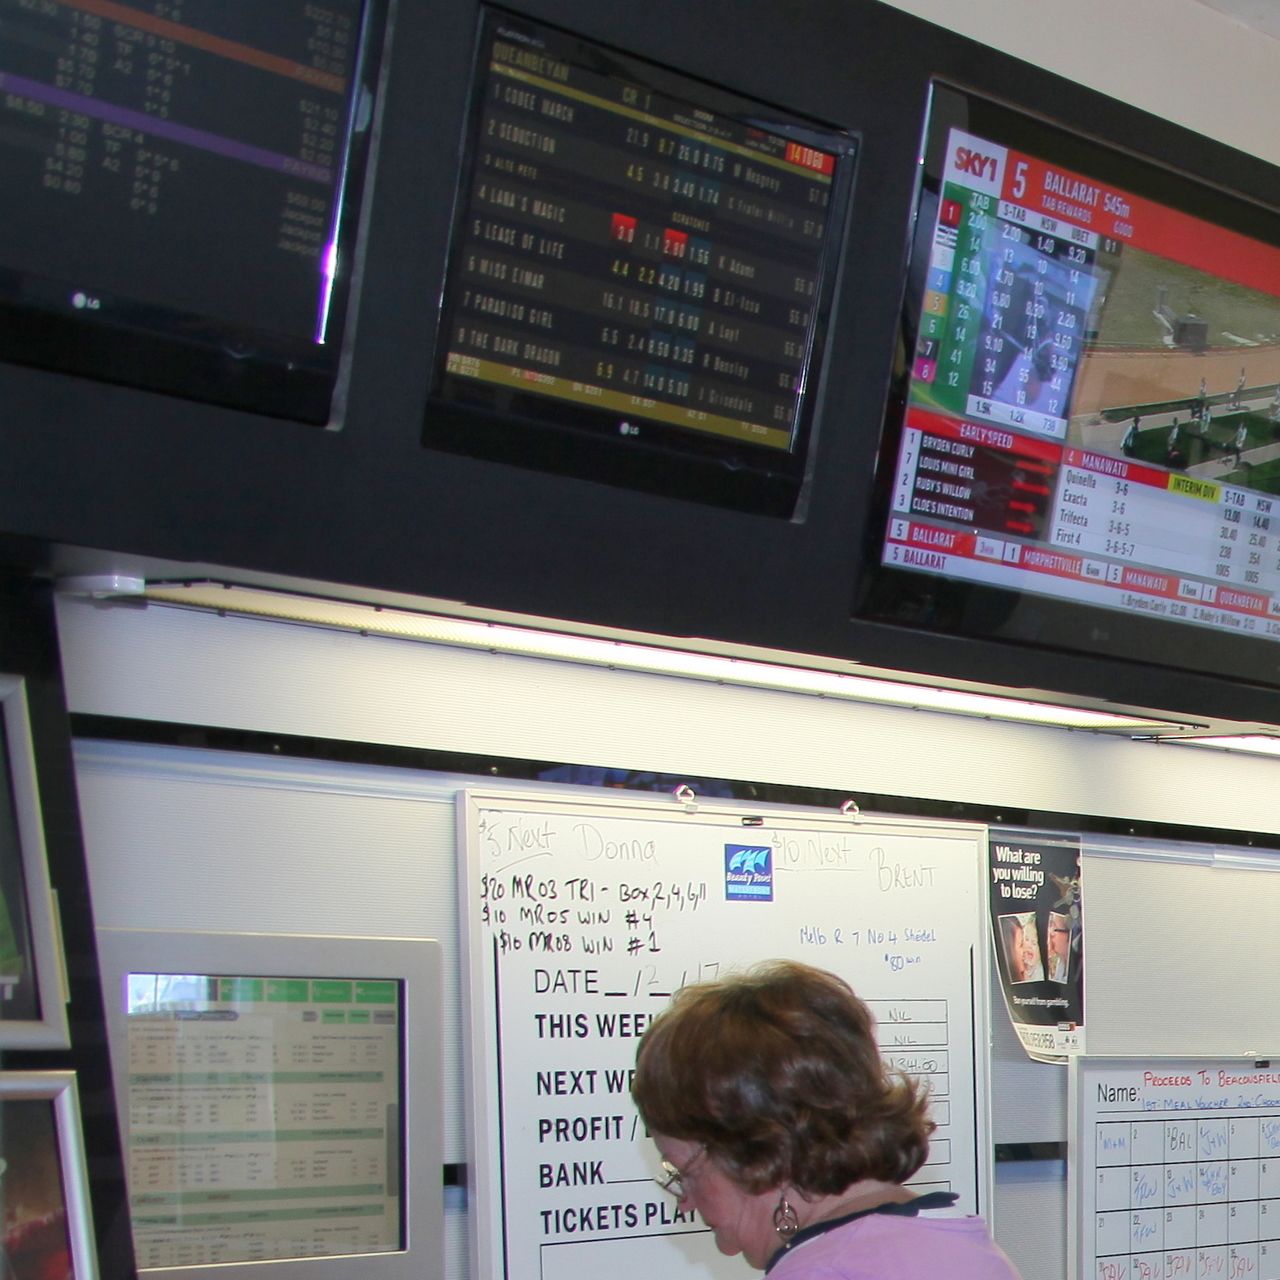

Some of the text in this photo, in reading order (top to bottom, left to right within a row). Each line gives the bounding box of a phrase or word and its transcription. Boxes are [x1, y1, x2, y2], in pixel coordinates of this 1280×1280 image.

[1044, 171, 1131, 218] BALLARAT 545m
[1056, 199, 1092, 223] REWARDS
[485, 223, 517, 247] LEASE
[539, 238, 566, 260] LIFE
[922, 435, 950, 454] BRYDEN
[960, 424, 1013, 449] EARLY SPEED
[958, 464, 974, 480] GIRL
[1065, 470, 1129, 497] Quinella 3-6
[1081, 453, 1246, 507] MANAWATU INTERIM DIV S-TAB
[942, 482, 971, 500] WILLOW
[1062, 489, 1126, 515] Exacta 3-6
[1059, 508, 1130, 536] Trifecta 3-6-5
[1055, 528, 1135, 557] First 3-6-5-7
[903, 550, 947, 570] BALLARAT
[912, 527, 1169, 592] BALLARAT MANAWATU
[507, 818, 658, 864] Next Donna
[808, 834, 852, 865] Next
[996, 846, 1042, 865] What are
[993, 865, 1045, 887] you willing
[1001, 883, 1038, 900] to lose?
[578, 909, 612, 925] WIN
[582, 936, 613, 956] WIN
[627, 931, 662, 956] #1
[534, 969, 600, 994] DATE
[534, 1013, 589, 1039] THIS
[537, 1070, 597, 1096] NEXT
[1097, 1083, 1141, 1103] Name:
[538, 1115, 624, 1144] PROFIT
[539, 1160, 605, 1189] BANK
[541, 1203, 638, 1235] TICKETS
